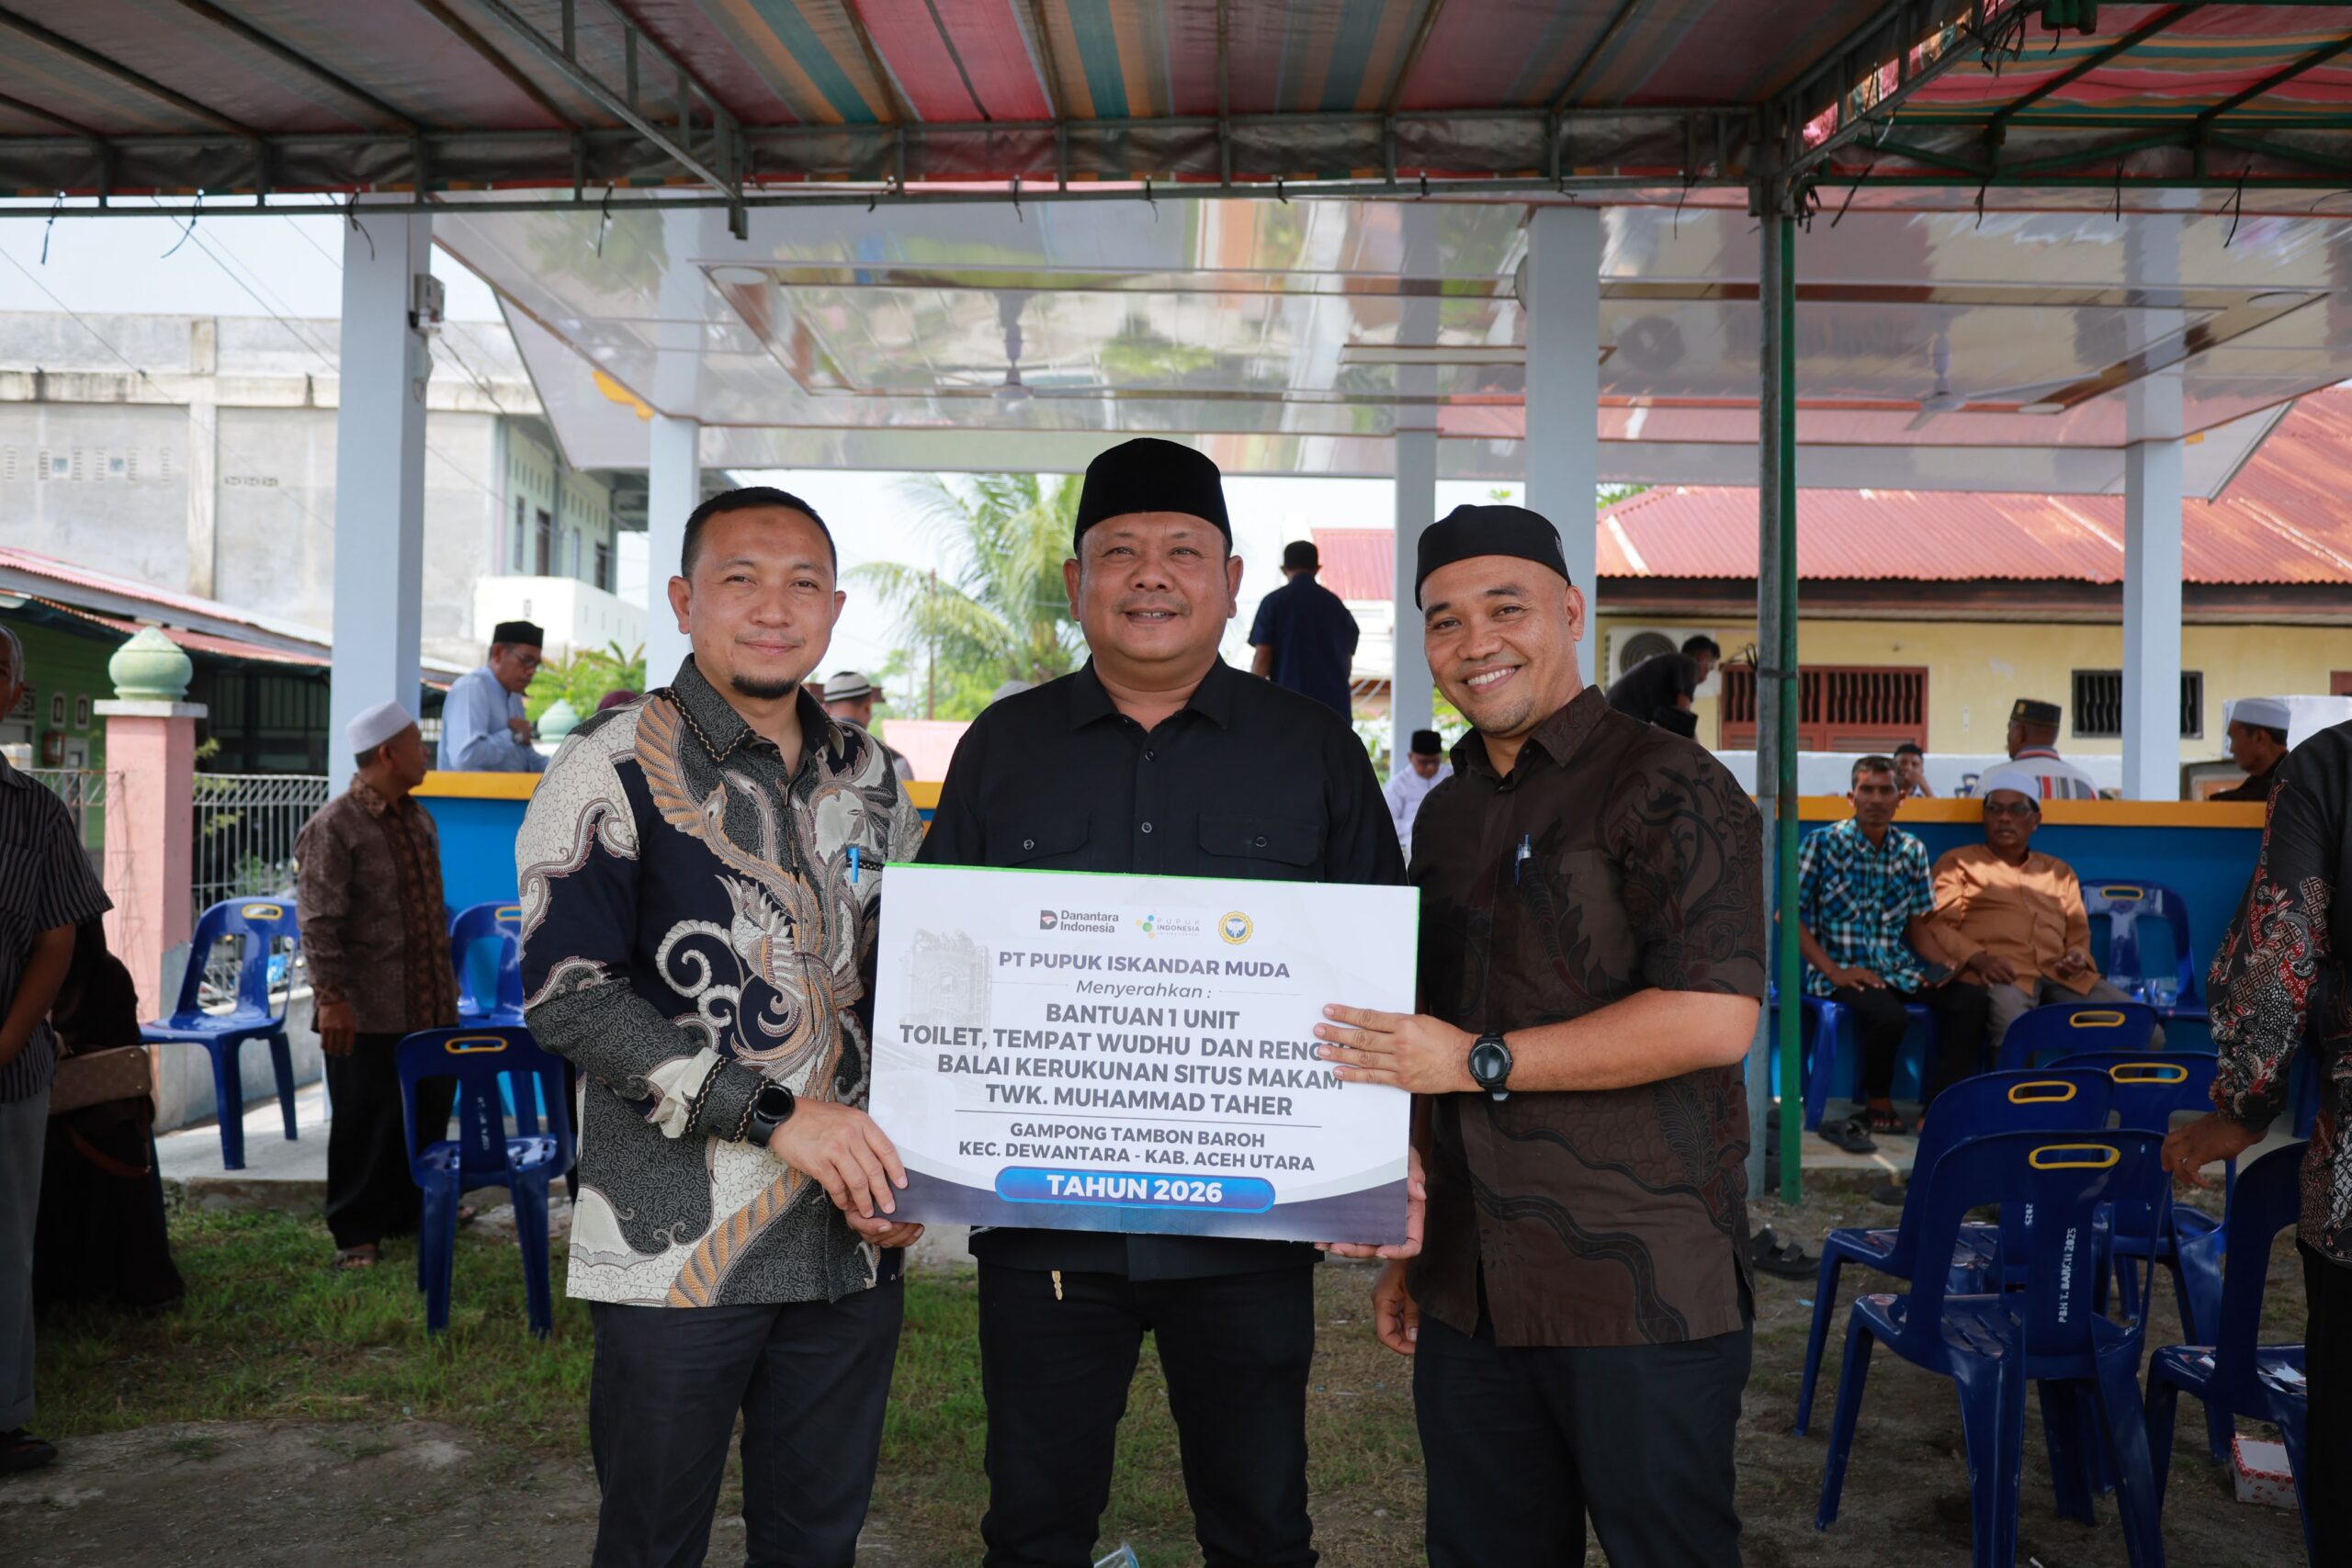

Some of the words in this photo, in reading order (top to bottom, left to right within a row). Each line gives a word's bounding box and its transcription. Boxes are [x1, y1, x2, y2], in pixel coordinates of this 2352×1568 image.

[1059, 920, 1115, 934] Indonesia
[1060, 909, 1119, 923] Danantara
[1157, 924, 1200, 932] INDONESIA
[999, 951, 1026, 967] PT
[1030, 953, 1102, 971] PUPUK
[1107, 955, 1220, 976] ISKANDAR
[1225, 960, 1291, 978] MUDA
[1076, 979, 1203, 998] Menyerahkan
[1046, 1003, 1165, 1028] BANTUAN
[1168, 1008, 1177, 1028] 1
[1183, 1009, 1240, 1030] UNIT
[899, 1024, 988, 1050] TOILET,
[992, 1028, 1092, 1051] TEMPAT
[1096, 1032, 1191, 1056] WUDHU
[1201, 1037, 1253, 1058] DAN
[937, 1054, 1010, 1076] BALAI
[1015, 1057, 1169, 1083] KERUKUNAN
[1173, 1064, 1242, 1086] SITUS
[1248, 1067, 1346, 1090] MAKAM
[985, 1083, 1048, 1105] TWK.
[1054, 1087, 1205, 1112] MUHAMMAD
[1210, 1093, 1293, 1116] TAHER
[1010, 1122, 1107, 1141] GAMPONG
[1110, 1127, 1193, 1145] TAMBON
[1197, 1131, 1265, 1148] BAROH
[958, 1141, 1001, 1156] KEC.
[1005, 1143, 1130, 1163] DEWANTARA
[1145, 1149, 1189, 1166] KAB.
[1193, 1151, 1246, 1168] ACEH
[1250, 1154, 1315, 1171] UTARA
[1046, 1174, 1148, 1200] TAHUN
[1153, 1179, 1224, 1203] 2026
[2064, 1227, 2076, 1252] 2025
